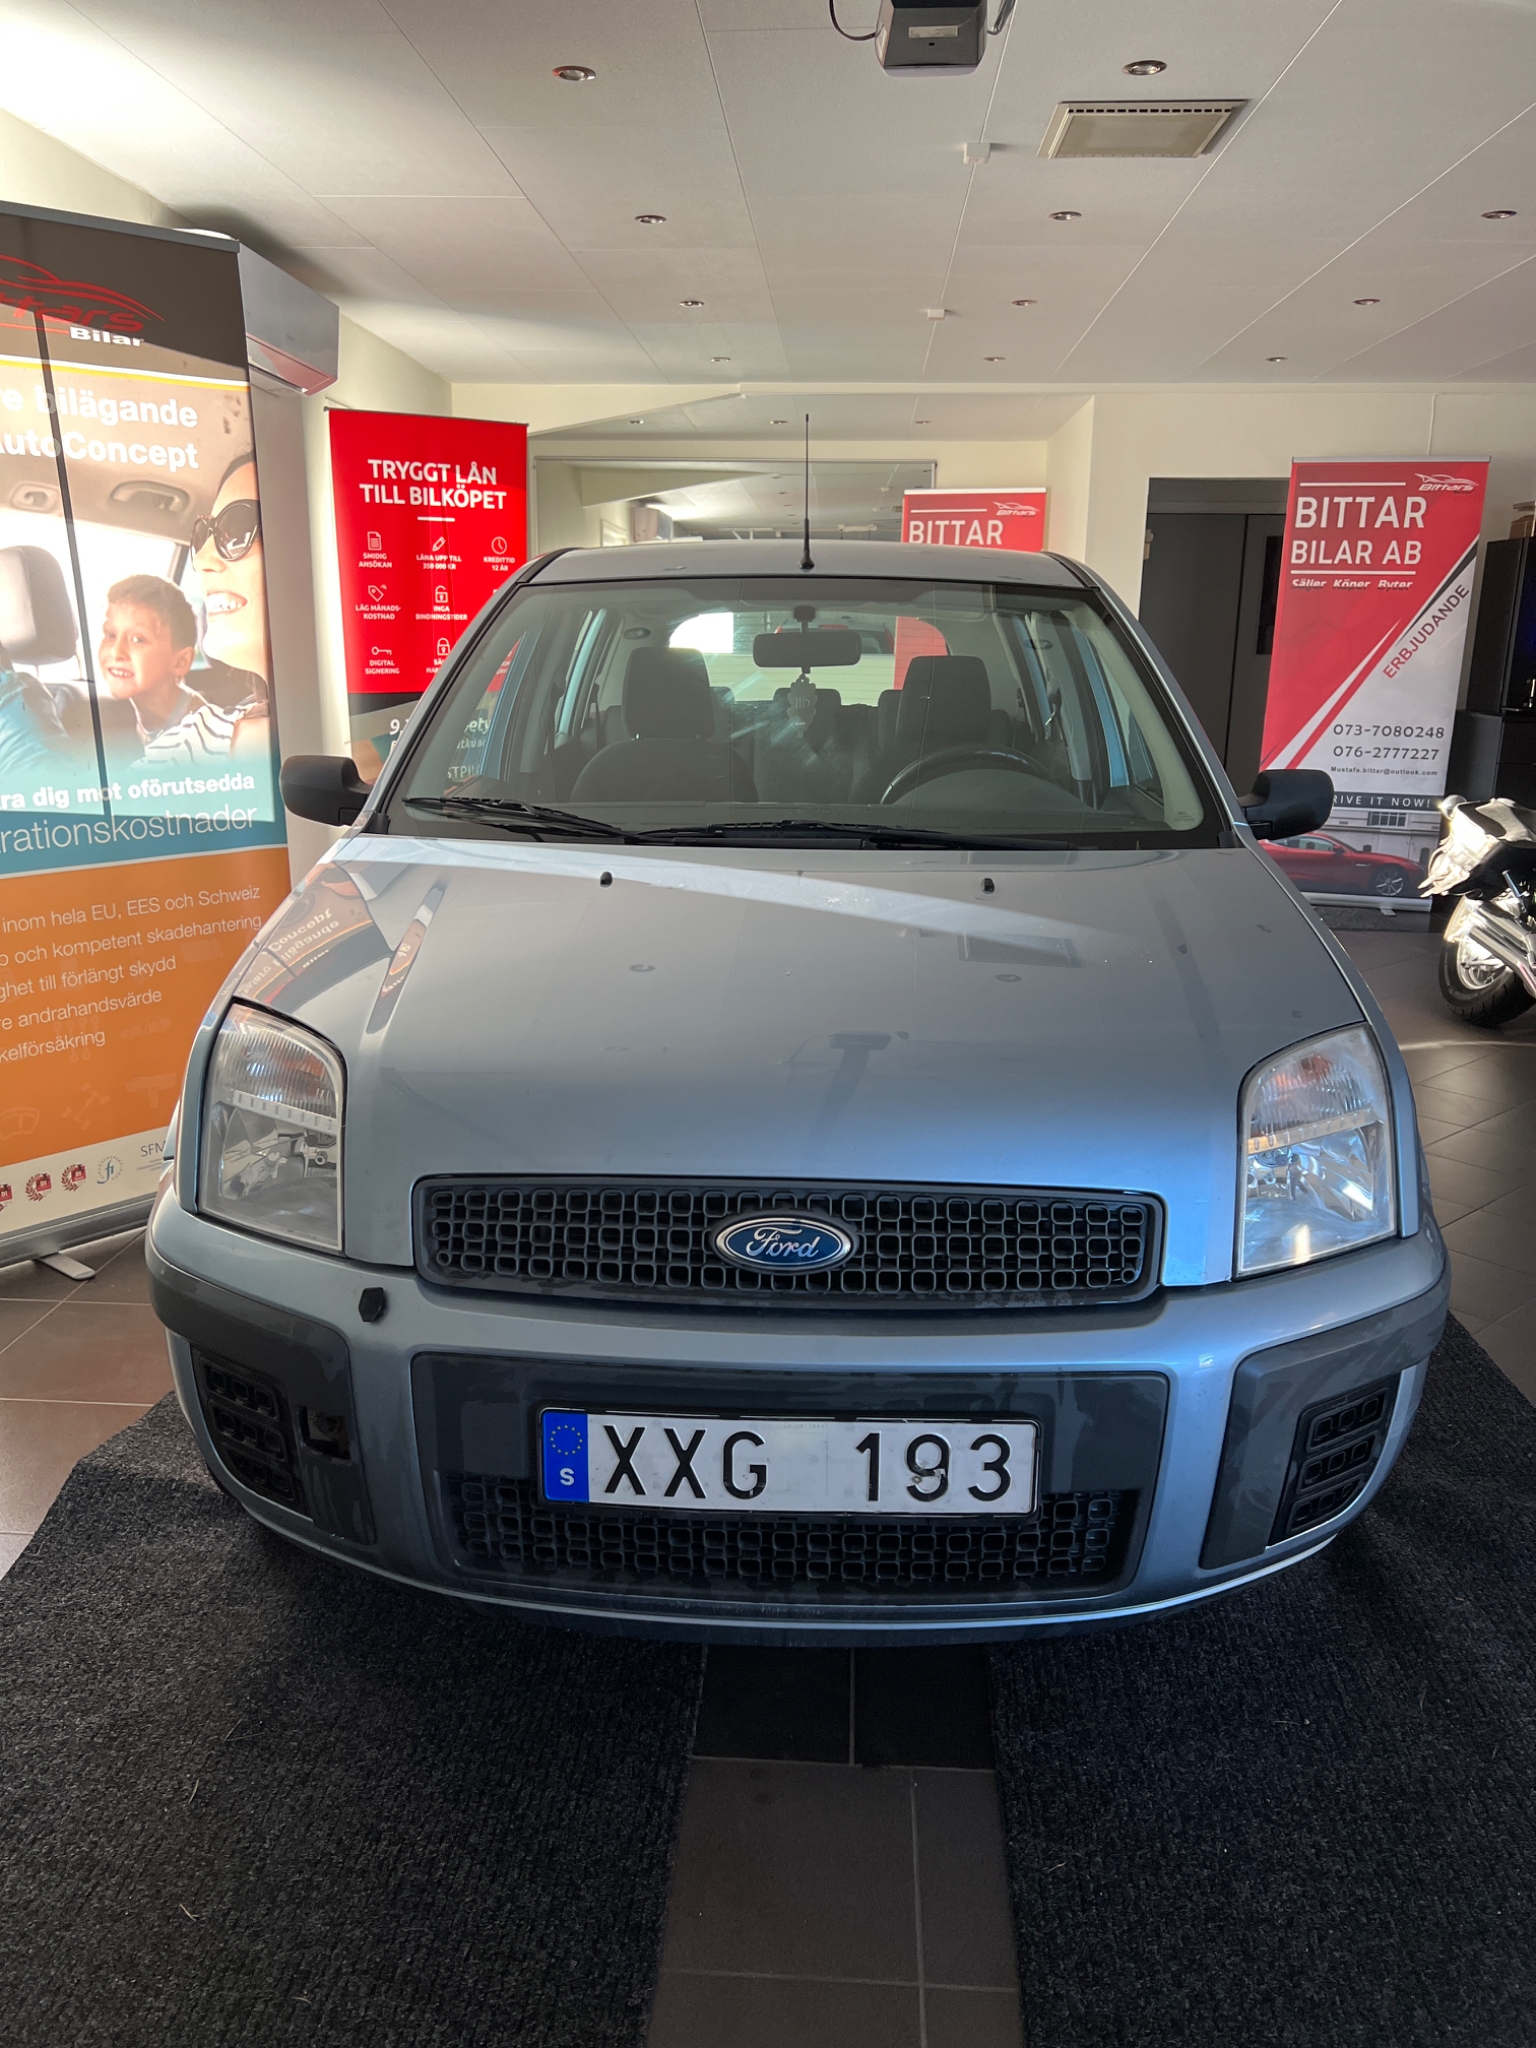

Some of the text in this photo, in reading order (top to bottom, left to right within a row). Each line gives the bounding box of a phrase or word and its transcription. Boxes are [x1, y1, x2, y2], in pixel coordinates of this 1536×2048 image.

[69, 326, 144, 347] Bilar
[35, 384, 198, 428] bilägande
[367, 459, 497, 485] TRYGGT LÅN
[359, 484, 507, 509] TILL BILKÖPET
[1294, 496, 1428, 529] BITTAR
[908, 519, 1004, 546] BITTAR
[358, 561, 393, 569] ANSÖKAN
[363, 552, 387, 560] SMIDIG
[416, 553, 434, 561] LÅNA
[1290, 540, 1423, 565] BILAR AB
[355, 604, 369, 612] LÅG
[1382, 584, 1470, 679] ERBJUDANDE
[1333, 723, 1445, 739] 073-7080248
[1333, 745, 1440, 760] 076-2777227
[32, 786, 69, 809] dig
[77, 783, 122, 803] mot
[128, 774, 255, 798] oförutsedda
[1370, 796, 1383, 805] IT
[1391, 797, 1430, 808] NOW!
[2, 885, 261, 933] inom hela EU, EES och Schweiz
[15, 945, 47, 964] och
[53, 932, 143, 959] kompetent
[147, 914, 262, 944] skadehantering
[39, 974, 57, 992] till
[61, 964, 125, 988] förlängt
[129, 956, 177, 979] skydd
[18, 989, 162, 1027] andrahandsvärde
[745, 1226, 821, 1260] Ford
[560, 1425, 1012, 1503] S XXG 193
